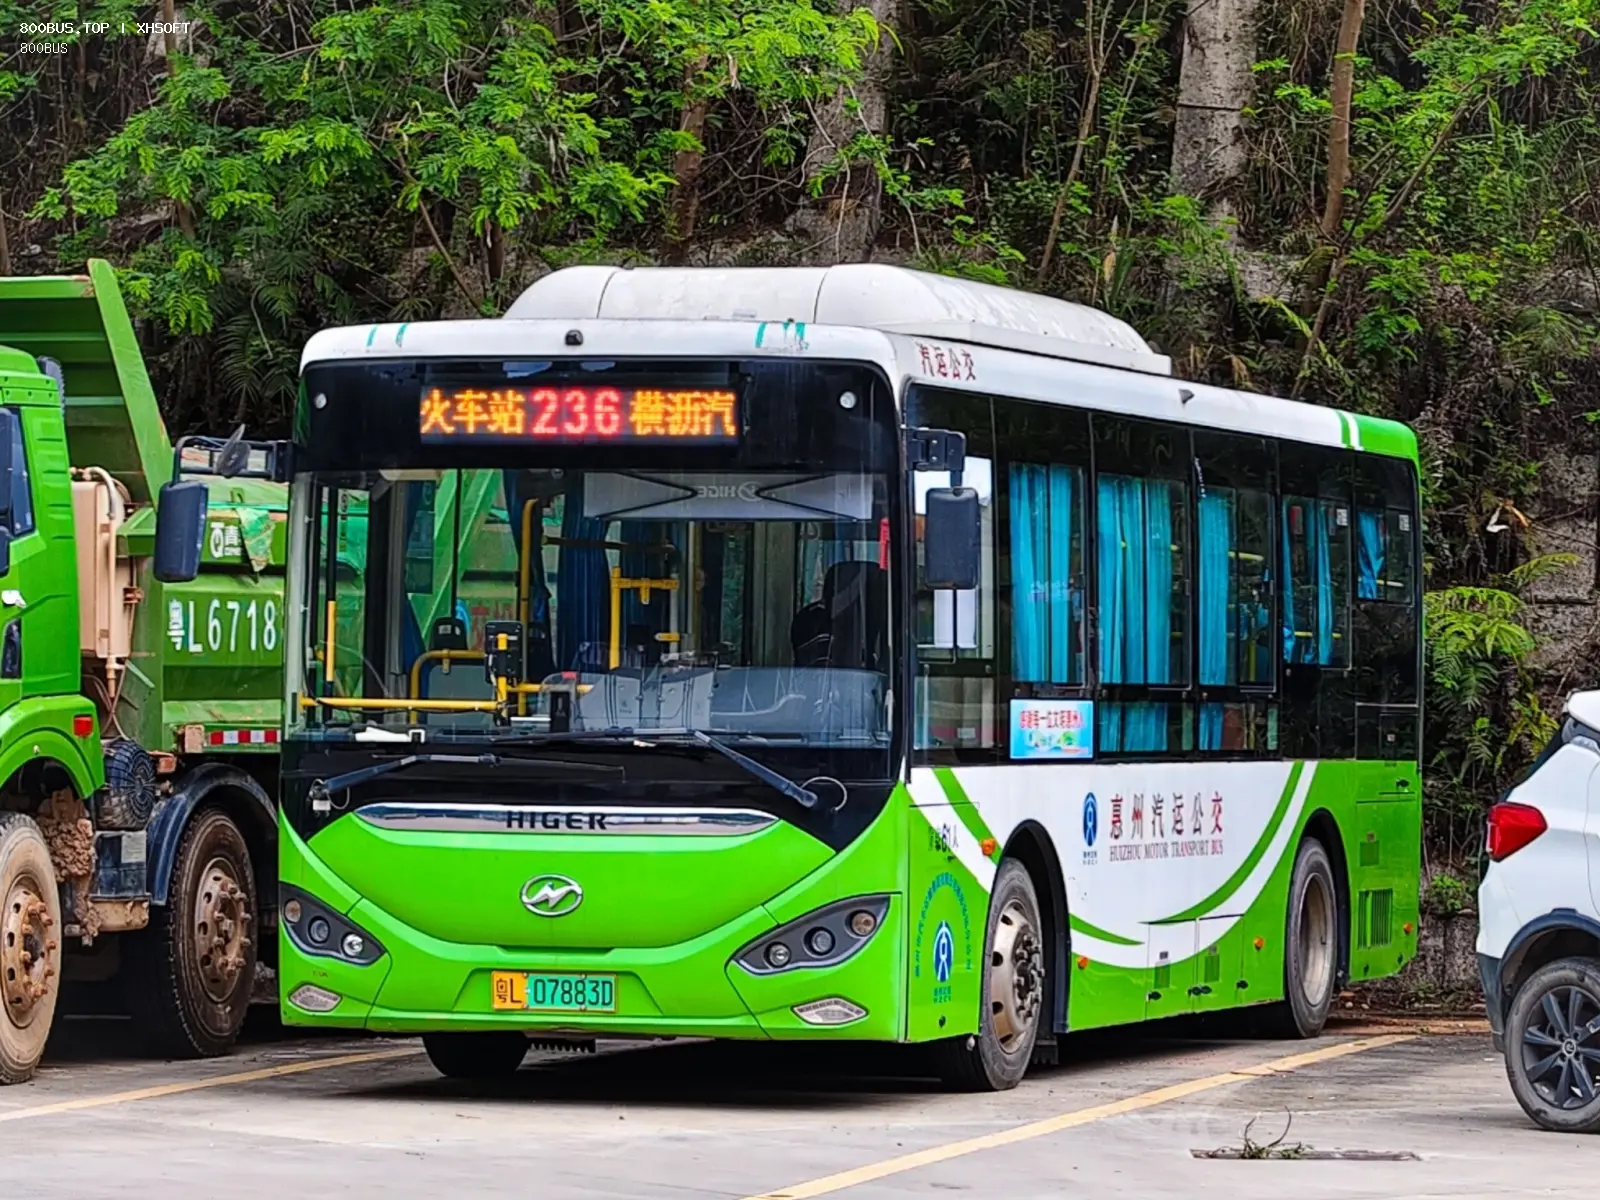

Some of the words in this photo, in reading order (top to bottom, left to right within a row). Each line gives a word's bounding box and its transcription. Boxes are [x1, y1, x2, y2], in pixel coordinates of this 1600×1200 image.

[915, 341, 976, 382] 汽运公交
[420, 389, 525, 435] 火车站
[531, 388, 621, 436] 236
[166, 598, 277, 653] 粤L6718
[506, 811, 607, 830] HIGER
[1110, 791, 1224, 840] 惠州汽运公交
[1109, 844, 1142, 861] HUIZHOU
[1143, 842, 1169, 859] MOTOR
[1171, 840, 1209, 857] TRANSPORT
[1211, 840, 1224, 855] BUS
[533, 979, 613, 1006] 07883D
